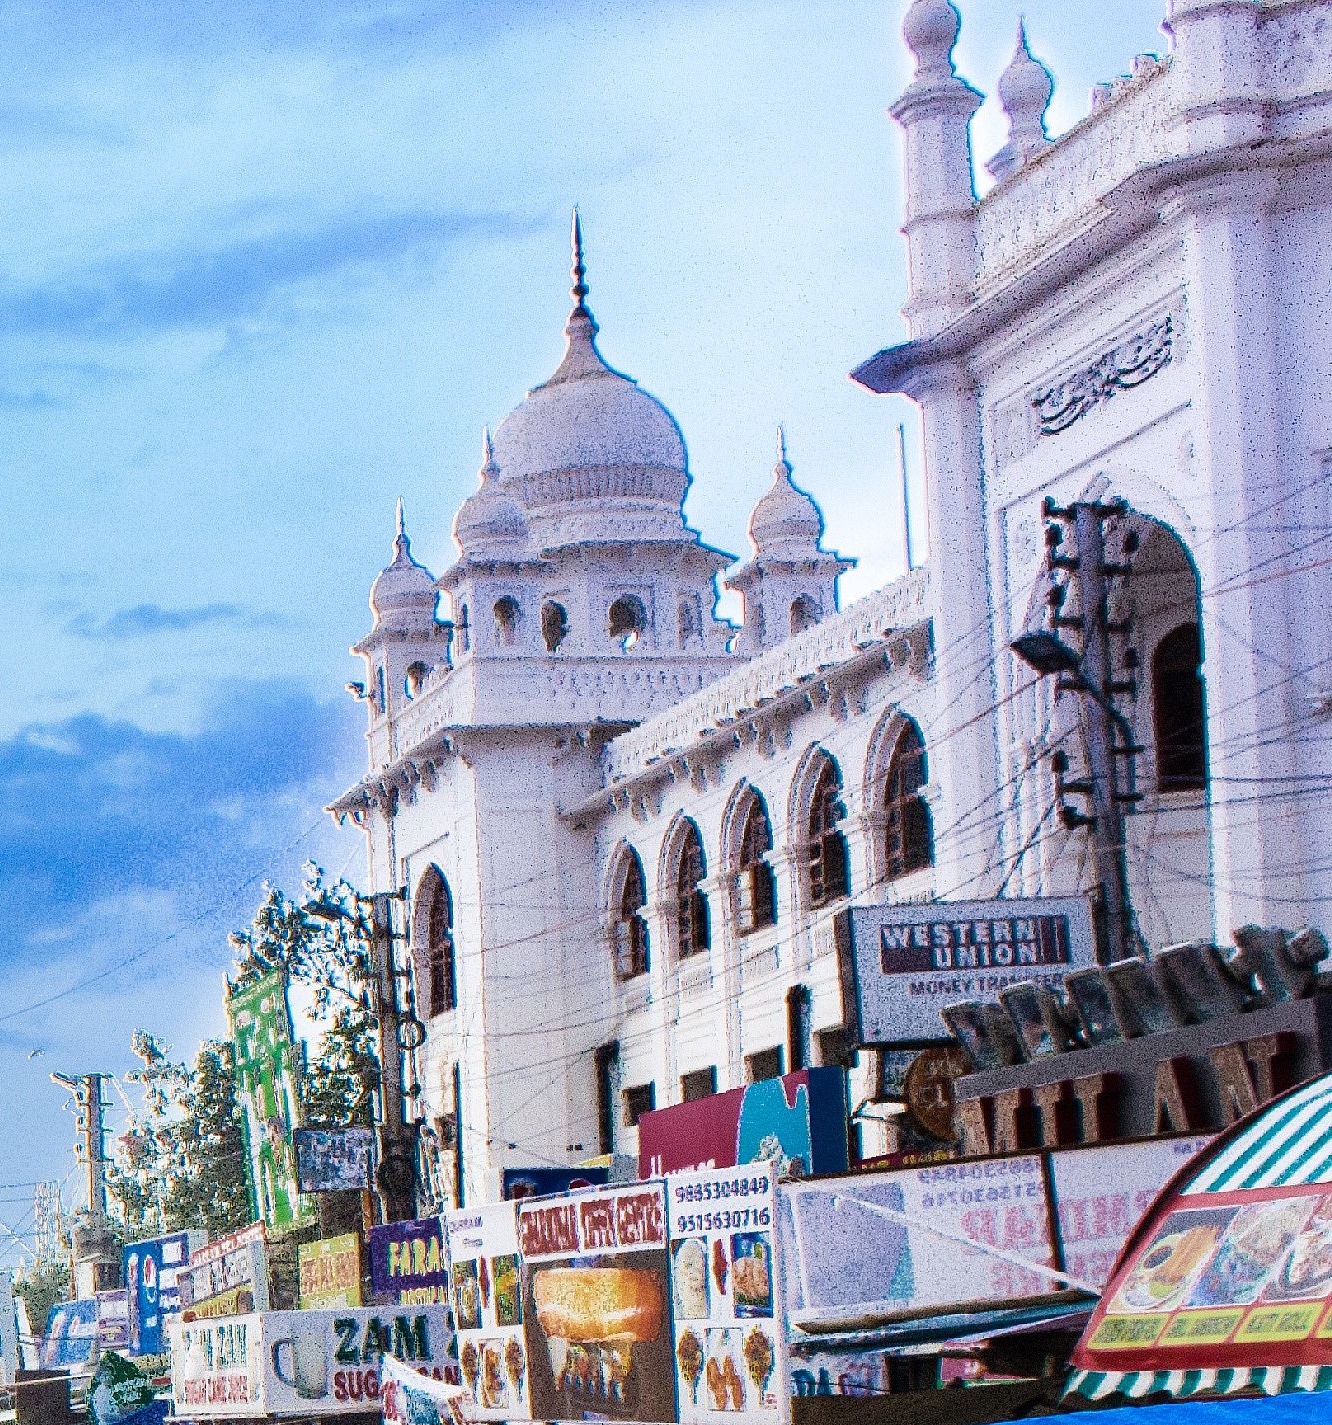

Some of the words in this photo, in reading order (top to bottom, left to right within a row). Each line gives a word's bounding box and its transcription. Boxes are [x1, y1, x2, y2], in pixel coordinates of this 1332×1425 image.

[882, 919, 1036, 949] WESTERN
[935, 942, 1037, 968] UNION
[908, 978, 973, 996] MONEY
[333, 1370, 383, 1401] SUG
